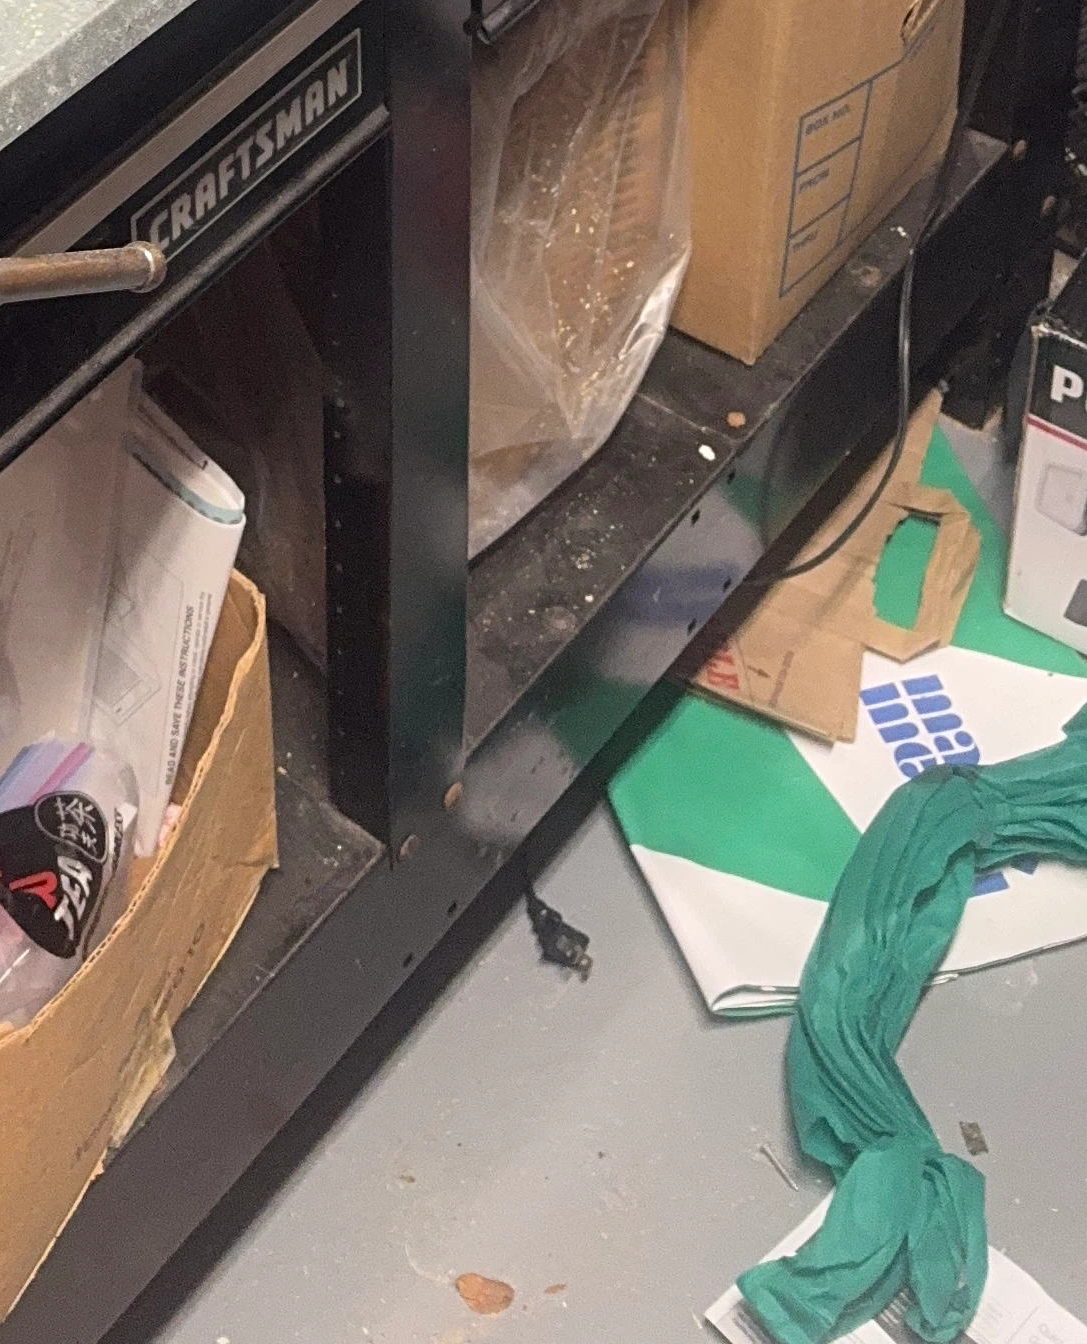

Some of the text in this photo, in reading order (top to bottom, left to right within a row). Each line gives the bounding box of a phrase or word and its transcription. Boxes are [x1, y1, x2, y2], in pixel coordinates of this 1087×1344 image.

[150, 59, 348, 250] CRAFTSMAN
[179, 605, 195, 678] INSTRUCTIONS
[171, 712, 182, 737] SAVE
[174, 679, 186, 711] THESE
[54, 855, 93, 941] TEA
